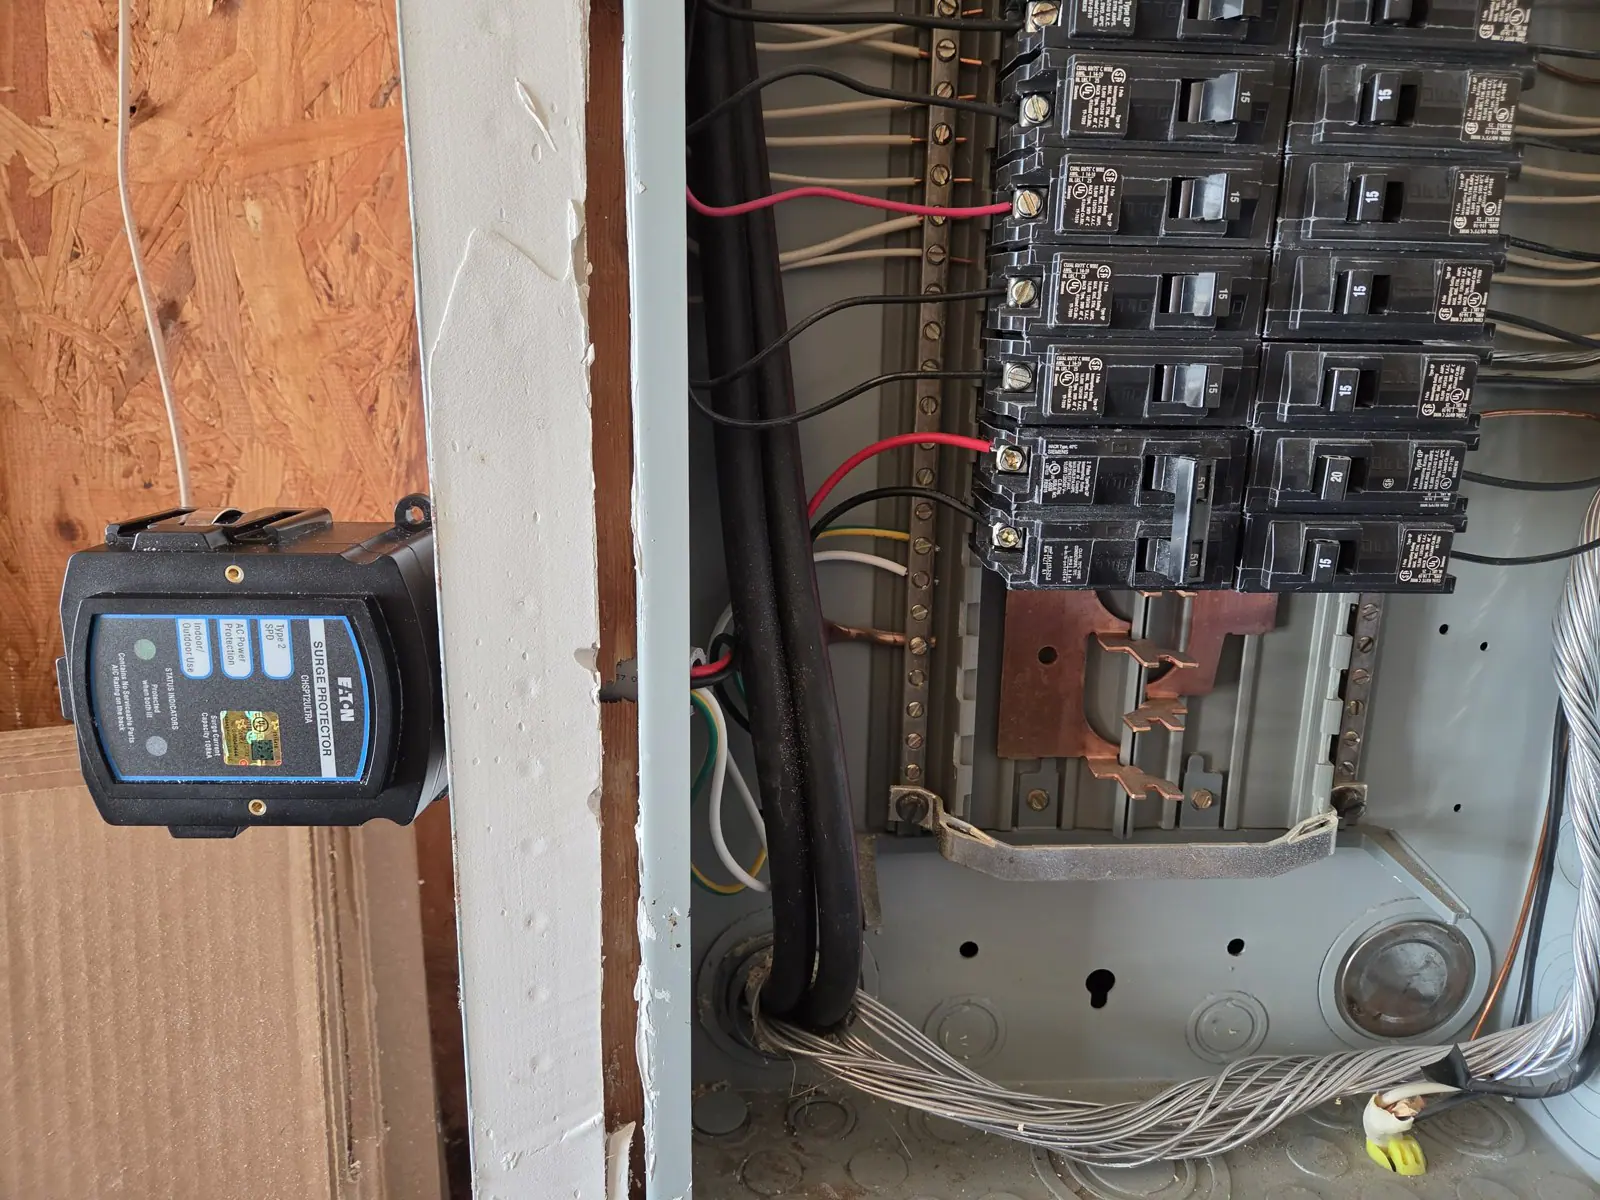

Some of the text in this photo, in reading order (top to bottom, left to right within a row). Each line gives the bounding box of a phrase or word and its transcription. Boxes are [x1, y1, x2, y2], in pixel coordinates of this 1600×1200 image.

[1123, 17, 1130, 27] QP
[1241, 91, 1251, 104] 15
[1378, 88, 1392, 102] 15
[1230, 191, 1240, 203] 15
[1365, 191, 1380, 204] 15
[1218, 288, 1228, 300] 15
[1353, 286, 1367, 297] 15
[1209, 383, 1218, 394] 15
[1339, 385, 1353, 396] 15
[1414, 449, 1424, 471] Type QP
[1197, 476, 1206, 490] 50
[1330, 471, 1343, 483] 20
[1190, 553, 1198, 567] 50
[1318, 558, 1332, 569] 15
[194, 622, 204, 652] Indoor/
[264, 624, 274, 641] SPD
[274, 624, 284, 642] Type
[182, 623, 195, 673] Outdoor Use
[224, 624, 235, 666] Protection
[236, 623, 246, 663] AC Power
[113, 676, 122, 696] Rating
[115, 697, 122, 705] on
[118, 652, 135, 743] Contains No Serviceable Parts
[151, 684, 161, 713] Protected
[165, 668, 179, 730] STATUS INDICATORS
[300, 674, 313, 724] CHSPT2ULTRA
[313, 641, 332, 756] SURGE PROTECTOR
[337, 677, 354, 722] EATON
[201, 712, 210, 738] Capacity
[210, 715, 221, 756] Surge Current
